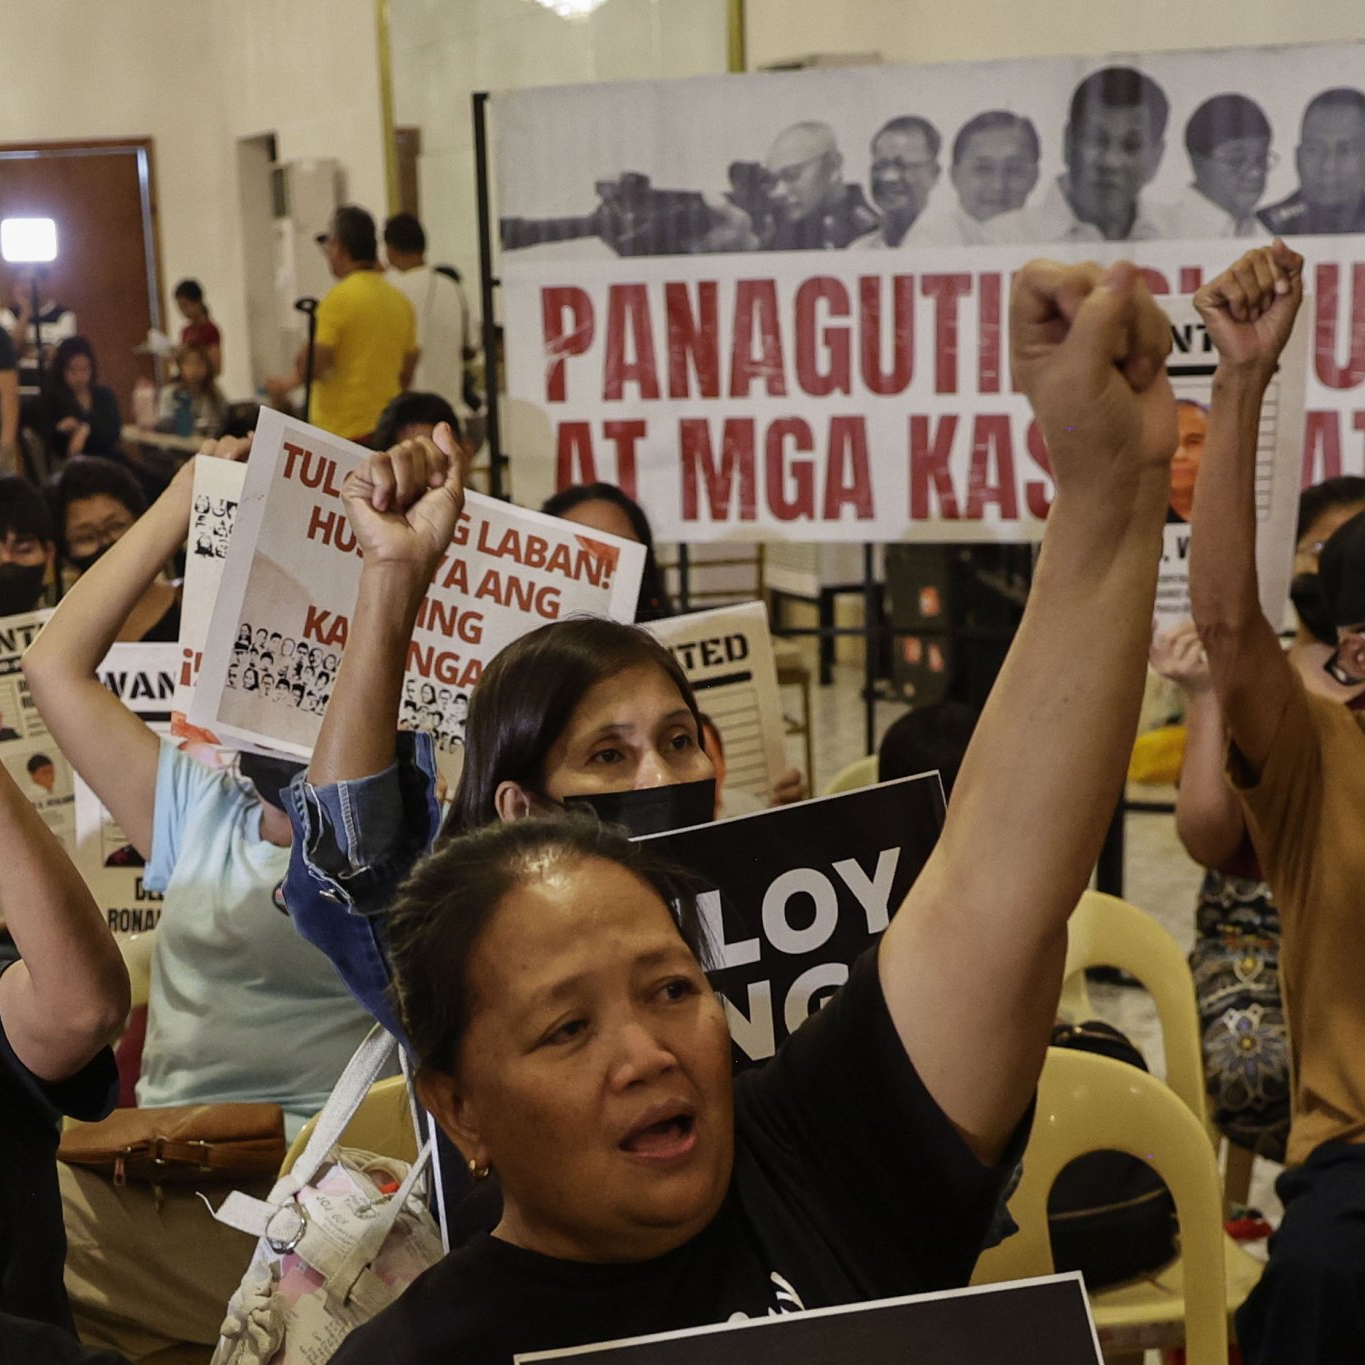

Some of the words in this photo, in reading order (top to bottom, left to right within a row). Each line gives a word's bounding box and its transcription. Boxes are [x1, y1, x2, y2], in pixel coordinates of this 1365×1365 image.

[542, 272, 1023, 404] PANAGUTI
[556, 418, 647, 500] AT
[680, 415, 874, 521] MGA
[283, 442, 355, 498] TUL
[477, 520, 614, 590] LABAN!
[474, 569, 562, 620] ANG
[416, 597, 484, 645] ING
[670, 633, 750, 670] TED
[102, 671, 175, 700] WAN
[108, 908, 161, 932] RONA
[672, 846, 901, 972] LOY
